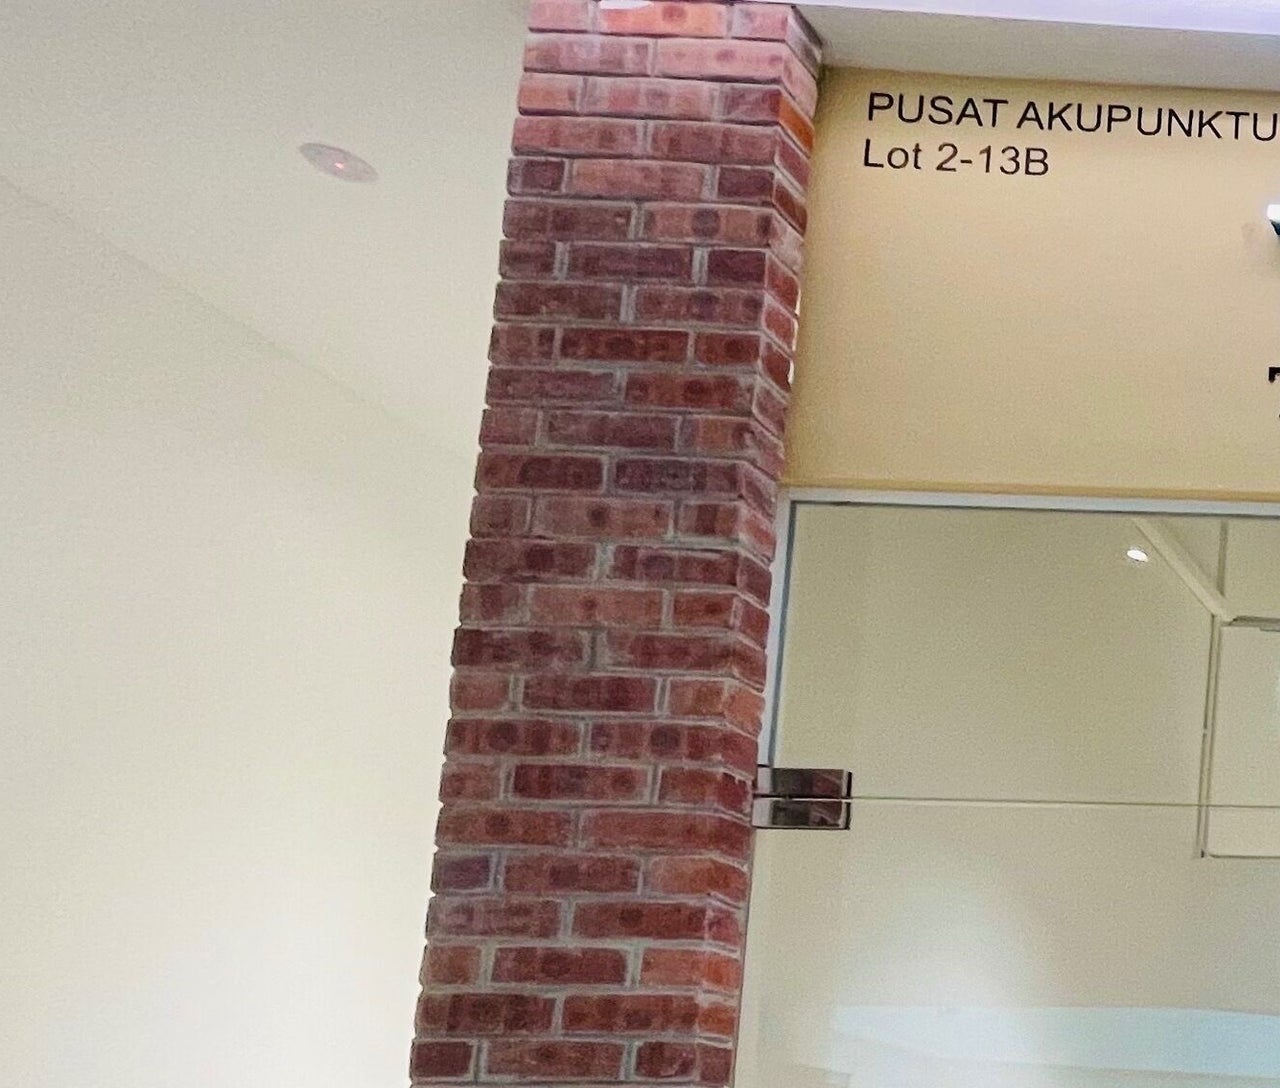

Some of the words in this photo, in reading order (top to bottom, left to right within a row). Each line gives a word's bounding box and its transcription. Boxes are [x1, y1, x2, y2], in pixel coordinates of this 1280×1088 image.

[868, 92, 1007, 128] PUSAT
[863, 139, 921, 170] Lot
[936, 143, 1049, 176] 2-13B
